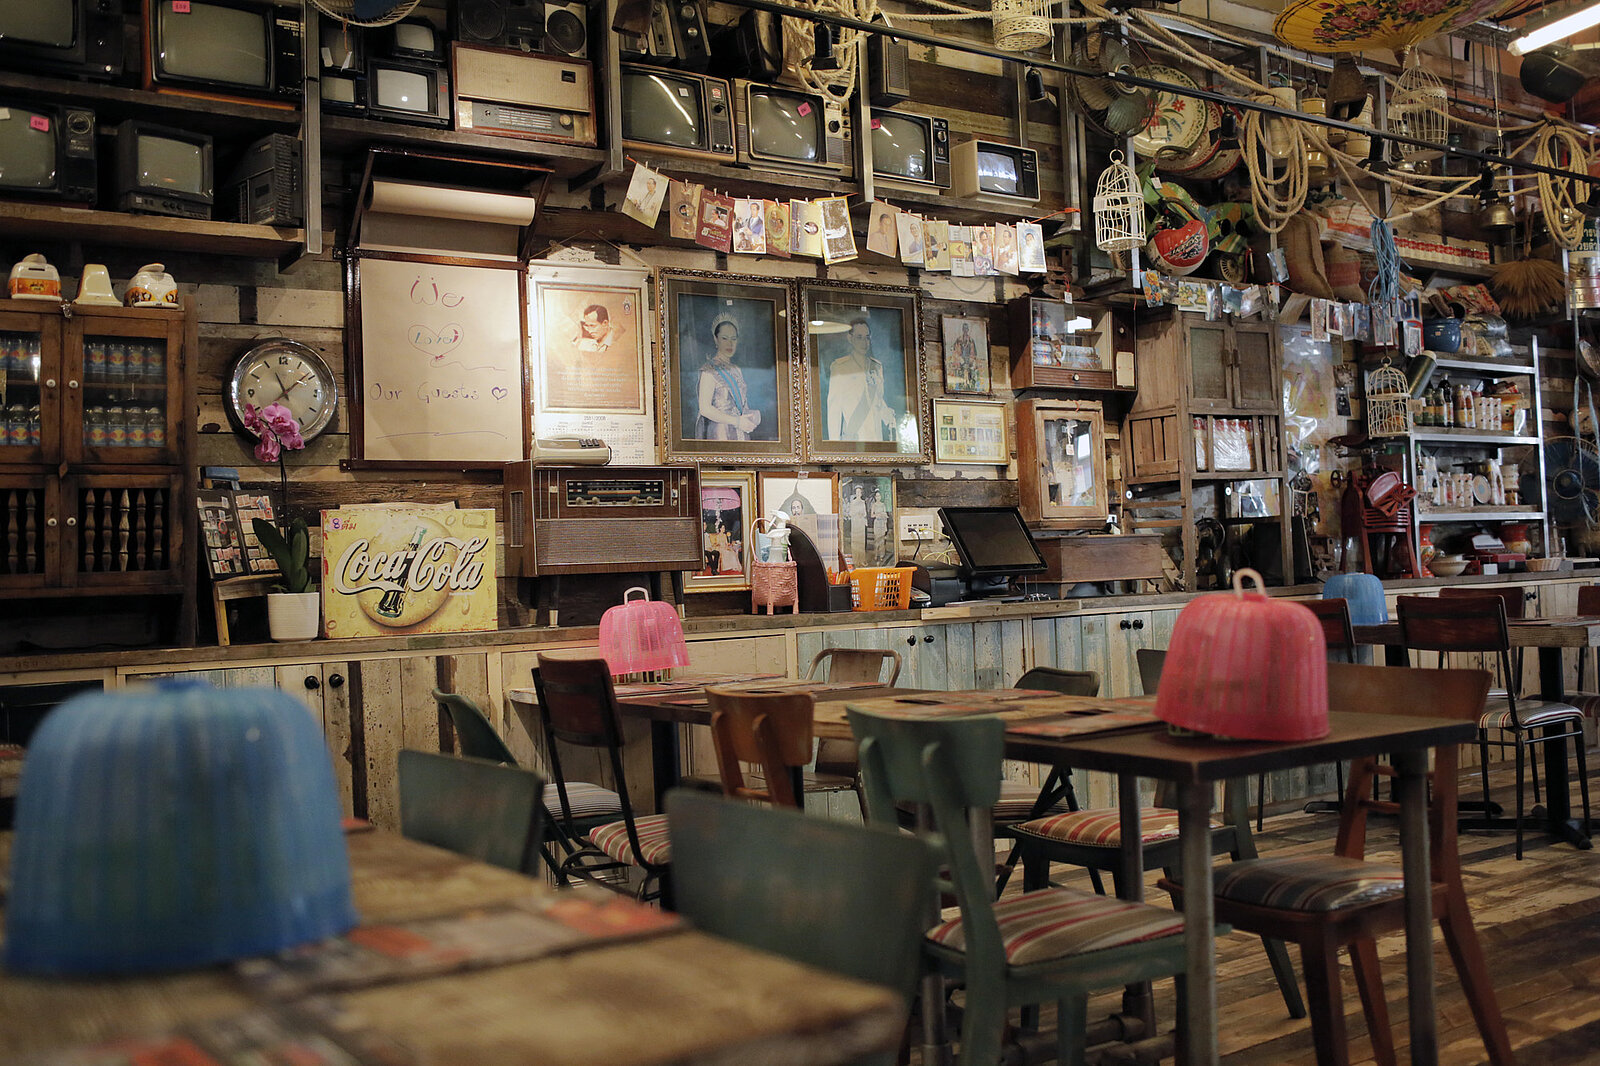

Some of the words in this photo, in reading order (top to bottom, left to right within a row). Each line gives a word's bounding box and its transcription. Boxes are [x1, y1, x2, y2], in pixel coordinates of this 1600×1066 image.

[410, 275, 465, 308] We
[414, 331, 453, 345] Love
[278, 355, 289, 366] 12
[247, 388, 255, 398] 9
[370, 382, 402, 401] Our
[417, 381, 480, 404] Guests
[334, 537, 489, 595] Coca-Cola
